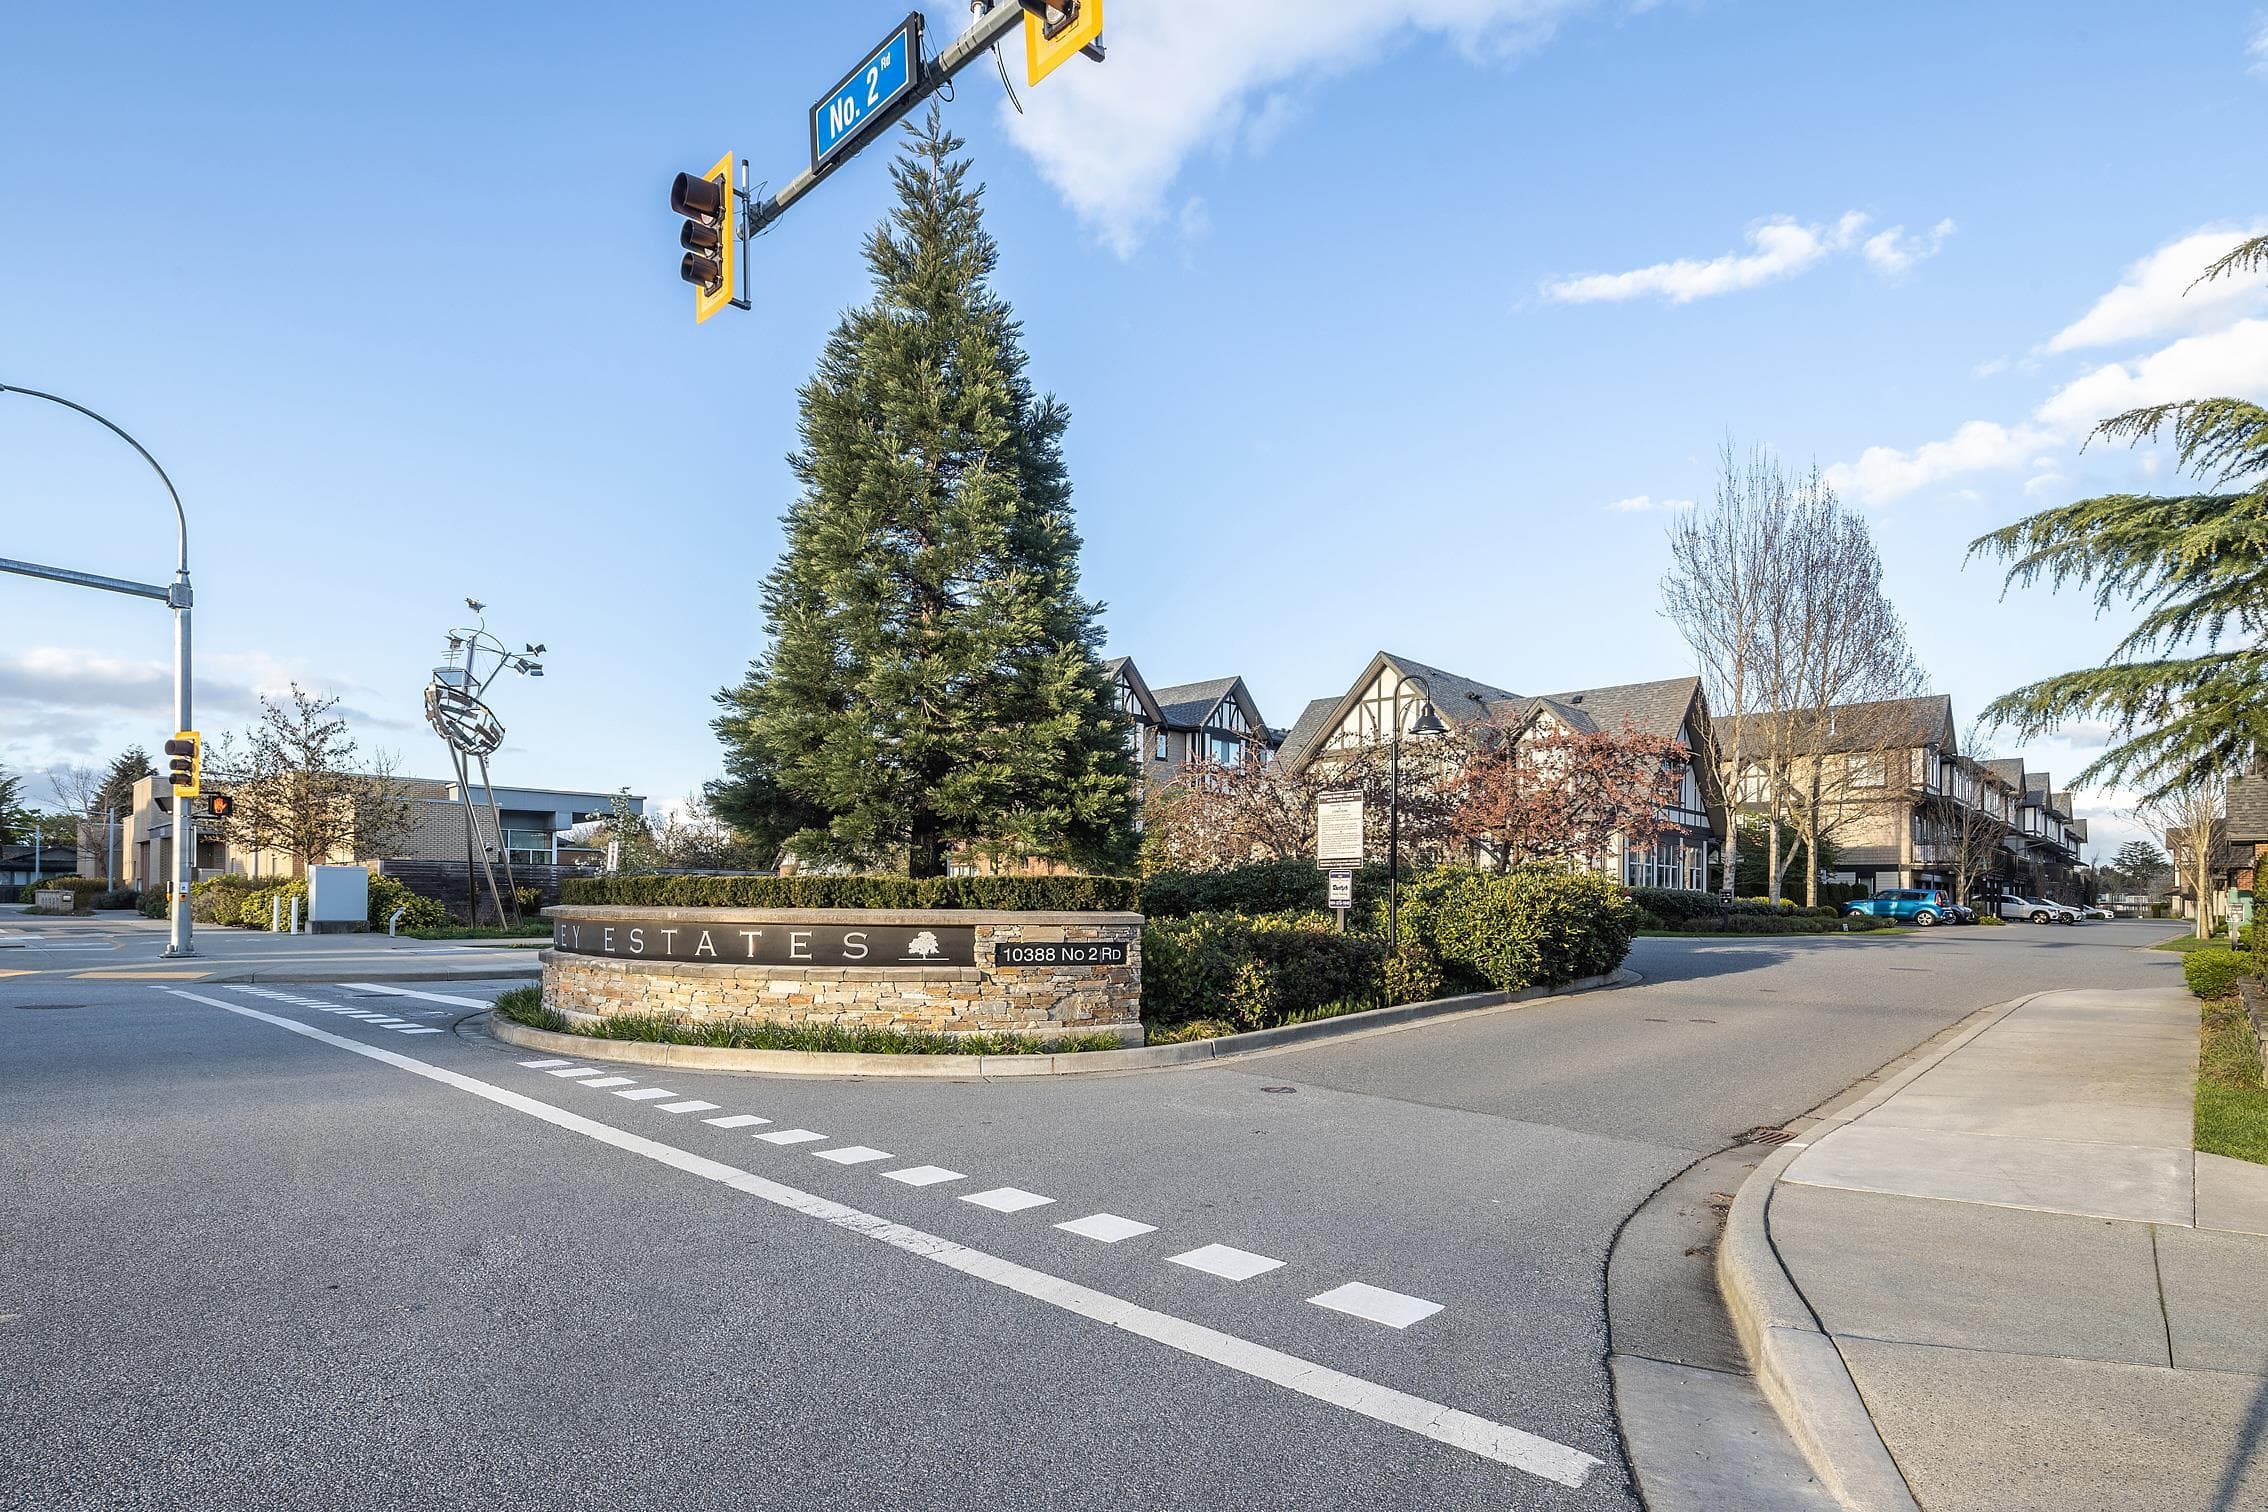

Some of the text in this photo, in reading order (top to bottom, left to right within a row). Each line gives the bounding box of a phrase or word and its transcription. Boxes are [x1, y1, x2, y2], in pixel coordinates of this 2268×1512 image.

[829, 51, 891, 140] No. 2 Rd
[604, 926, 869, 960] ESTATES
[1003, 947, 1056, 962] 10388
[1088, 947, 1098, 961] 2
